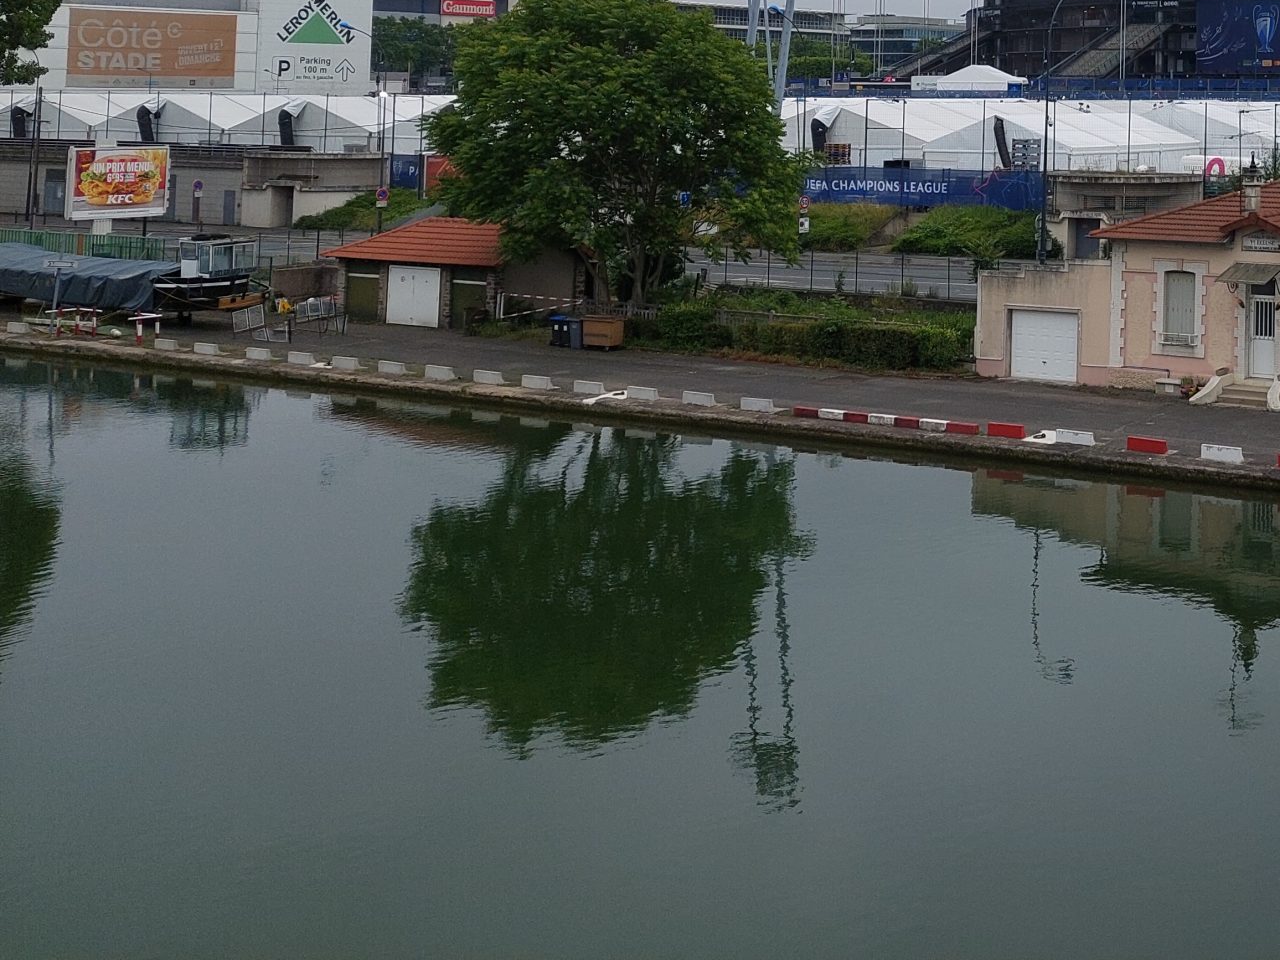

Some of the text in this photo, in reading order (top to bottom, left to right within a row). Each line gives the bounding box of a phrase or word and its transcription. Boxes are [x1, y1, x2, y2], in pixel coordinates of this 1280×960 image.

[443, 0, 494, 14] Gaumont
[276, 1, 314, 42] LEROY
[78, 19, 162, 48] Côté
[77, 50, 161, 70] STADE
[300, 57, 331, 66] Parking
[107, 162, 125, 172] PRIX
[127, 162, 149, 171] MENU
[832, 180, 899, 192] CHAMPIONS
[904, 182, 948, 194] LEAGUE
[107, 194, 133, 204] KFC
